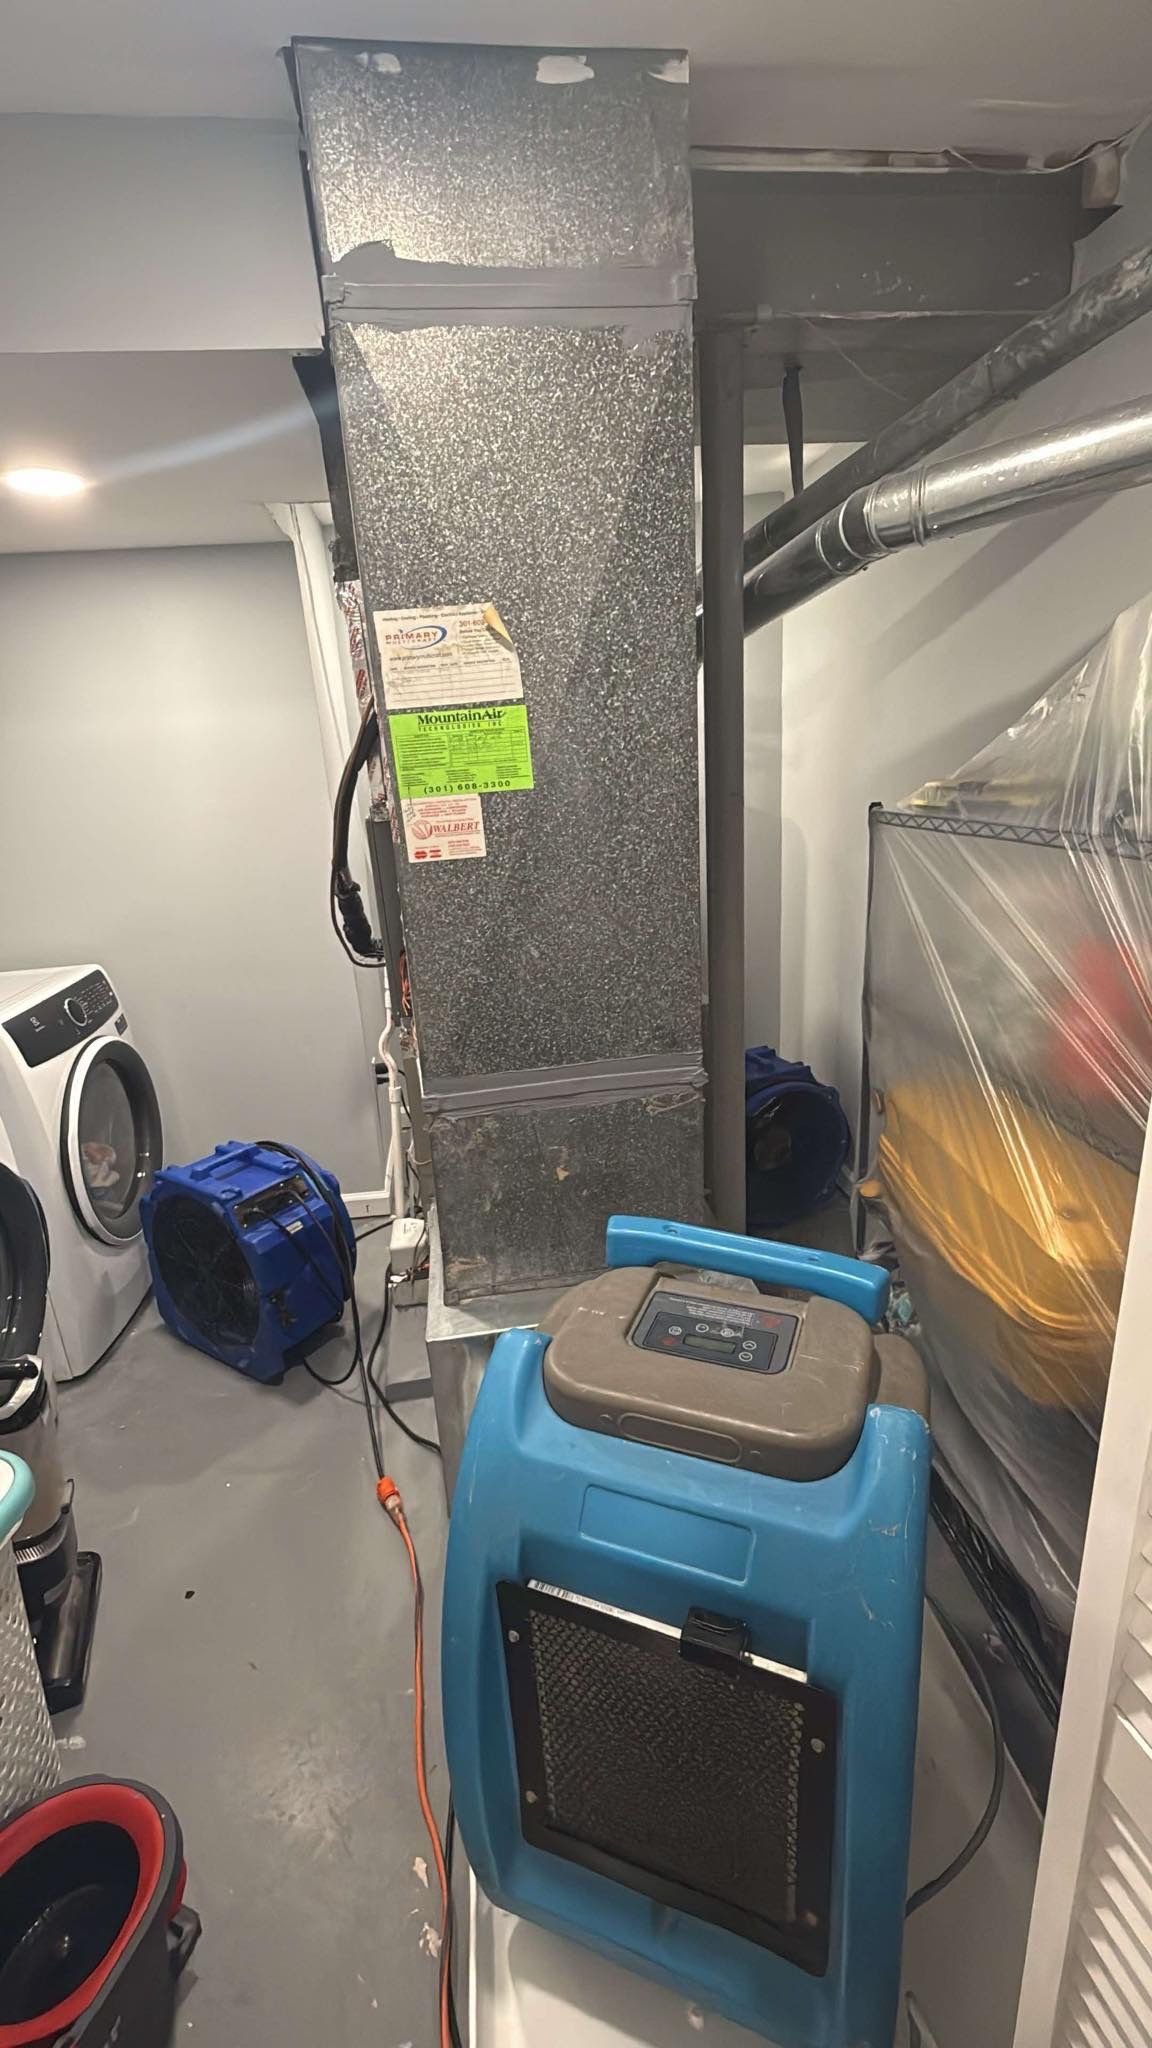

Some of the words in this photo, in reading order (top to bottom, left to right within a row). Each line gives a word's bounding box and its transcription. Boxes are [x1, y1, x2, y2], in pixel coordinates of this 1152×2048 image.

[385, 631, 438, 641] PRIMARY
[418, 722, 481, 732] TECHNOLOGIES
[487, 720, 502, 728] INC
[423, 785, 454, 795] (301)
[457, 780, 511, 792] 608-3300
[432, 821, 480, 833] WALBERT
